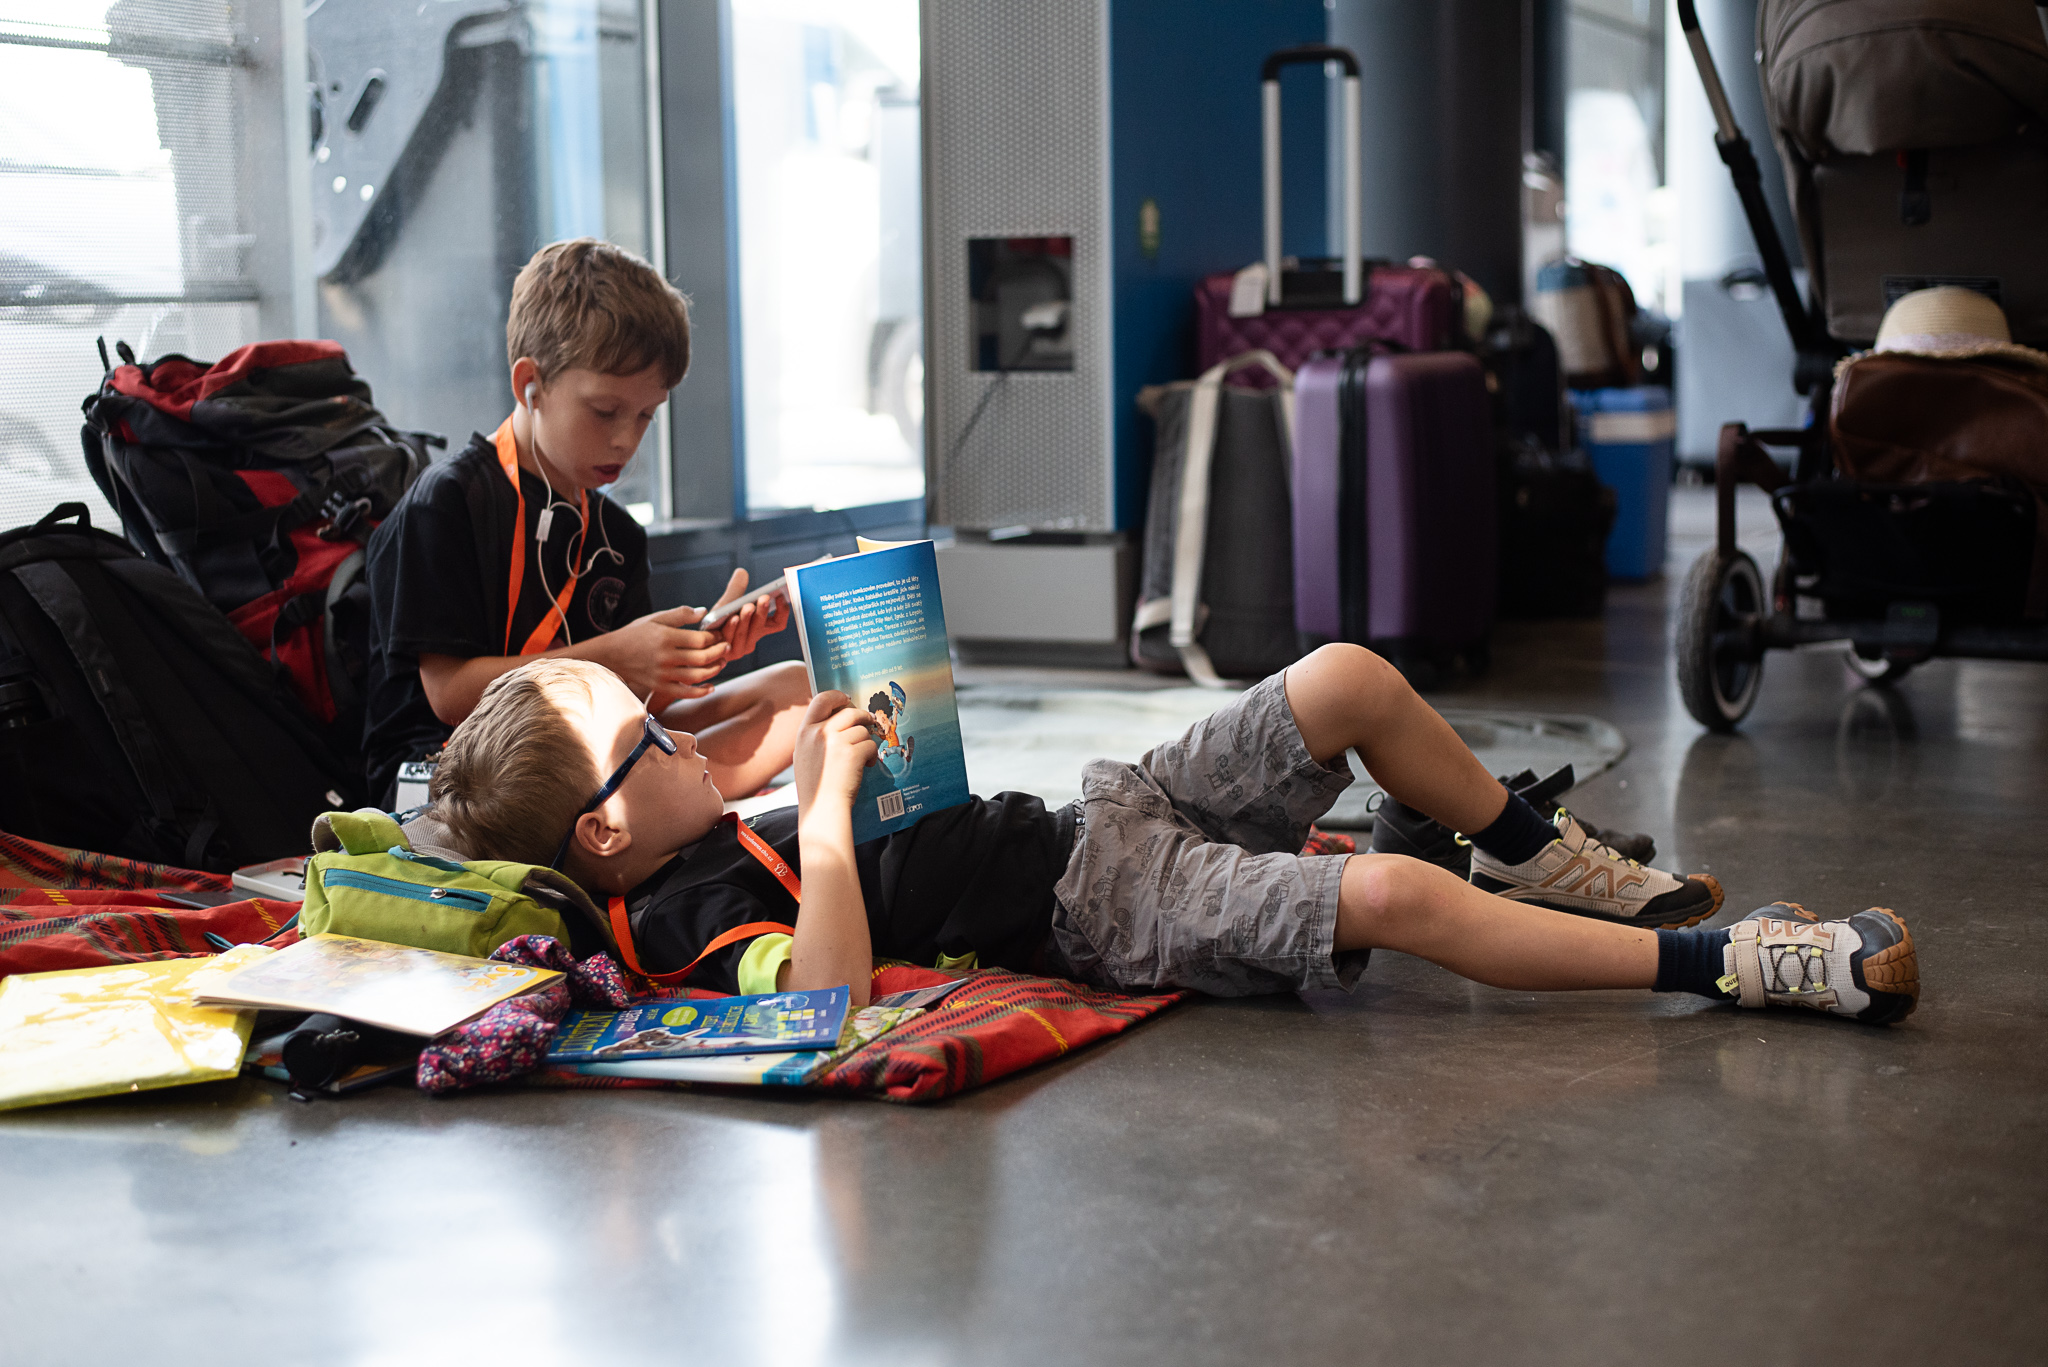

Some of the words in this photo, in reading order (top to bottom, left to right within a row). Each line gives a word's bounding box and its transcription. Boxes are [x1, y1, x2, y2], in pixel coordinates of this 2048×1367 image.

[618, 1009, 643, 1021] děti
[557, 1010, 618, 1052] LUŠTĚNÍ
[617, 1022, 636, 1032] pro
